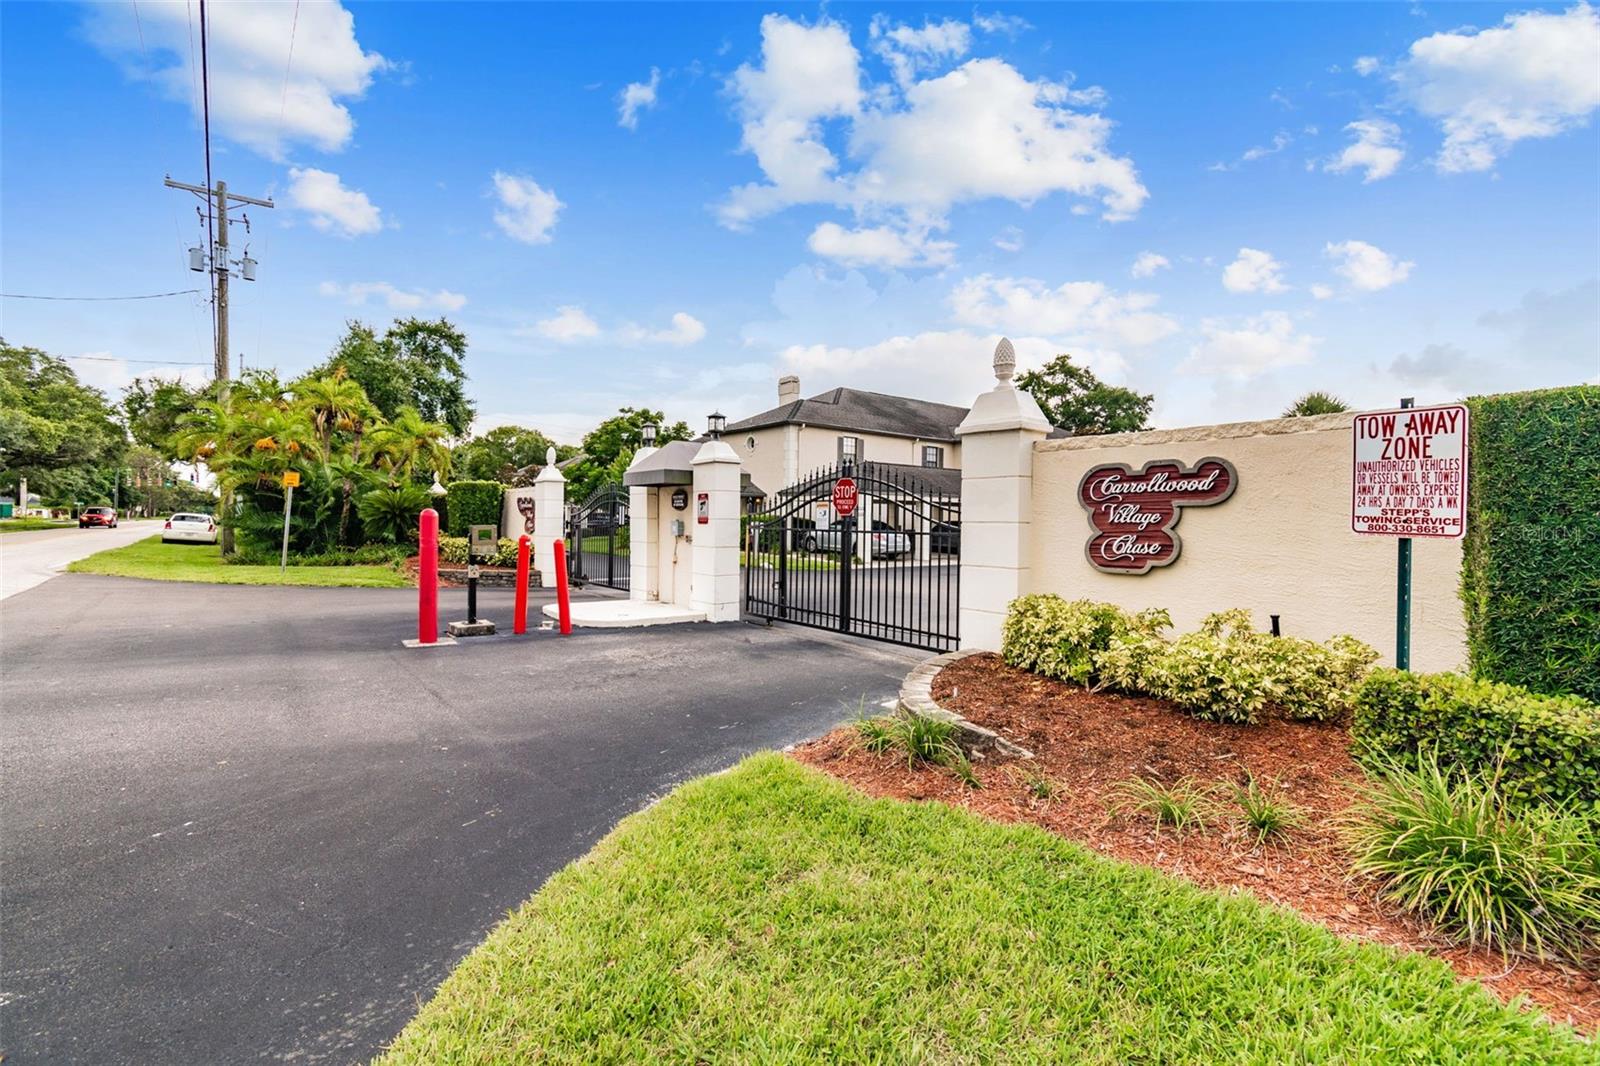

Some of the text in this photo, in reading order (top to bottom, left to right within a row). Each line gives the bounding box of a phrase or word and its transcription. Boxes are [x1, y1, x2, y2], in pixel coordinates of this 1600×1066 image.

[1358, 410, 1460, 439] TOW AWAY
[1381, 436, 1433, 460] ZONE
[1357, 458, 1460, 472] UNAUTHORIZED VEHICLES
[1357, 471, 1459, 484] OR VESSELS WILL BE TOWED
[835, 486, 855, 498] STOP
[1090, 470, 1219, 501] Carrollwood
[1357, 484, 1459, 496] AWAY AT OWNERS EXPENSE
[1357, 497, 1457, 508] 24 HRS A DAY 7 DAYS A WK
[1102, 504, 1161, 530] Village
[1406, 517, 1460, 526] SERVICE
[1368, 524, 1445, 533] 800-330-8651
[1101, 535, 1161, 561] Chase
